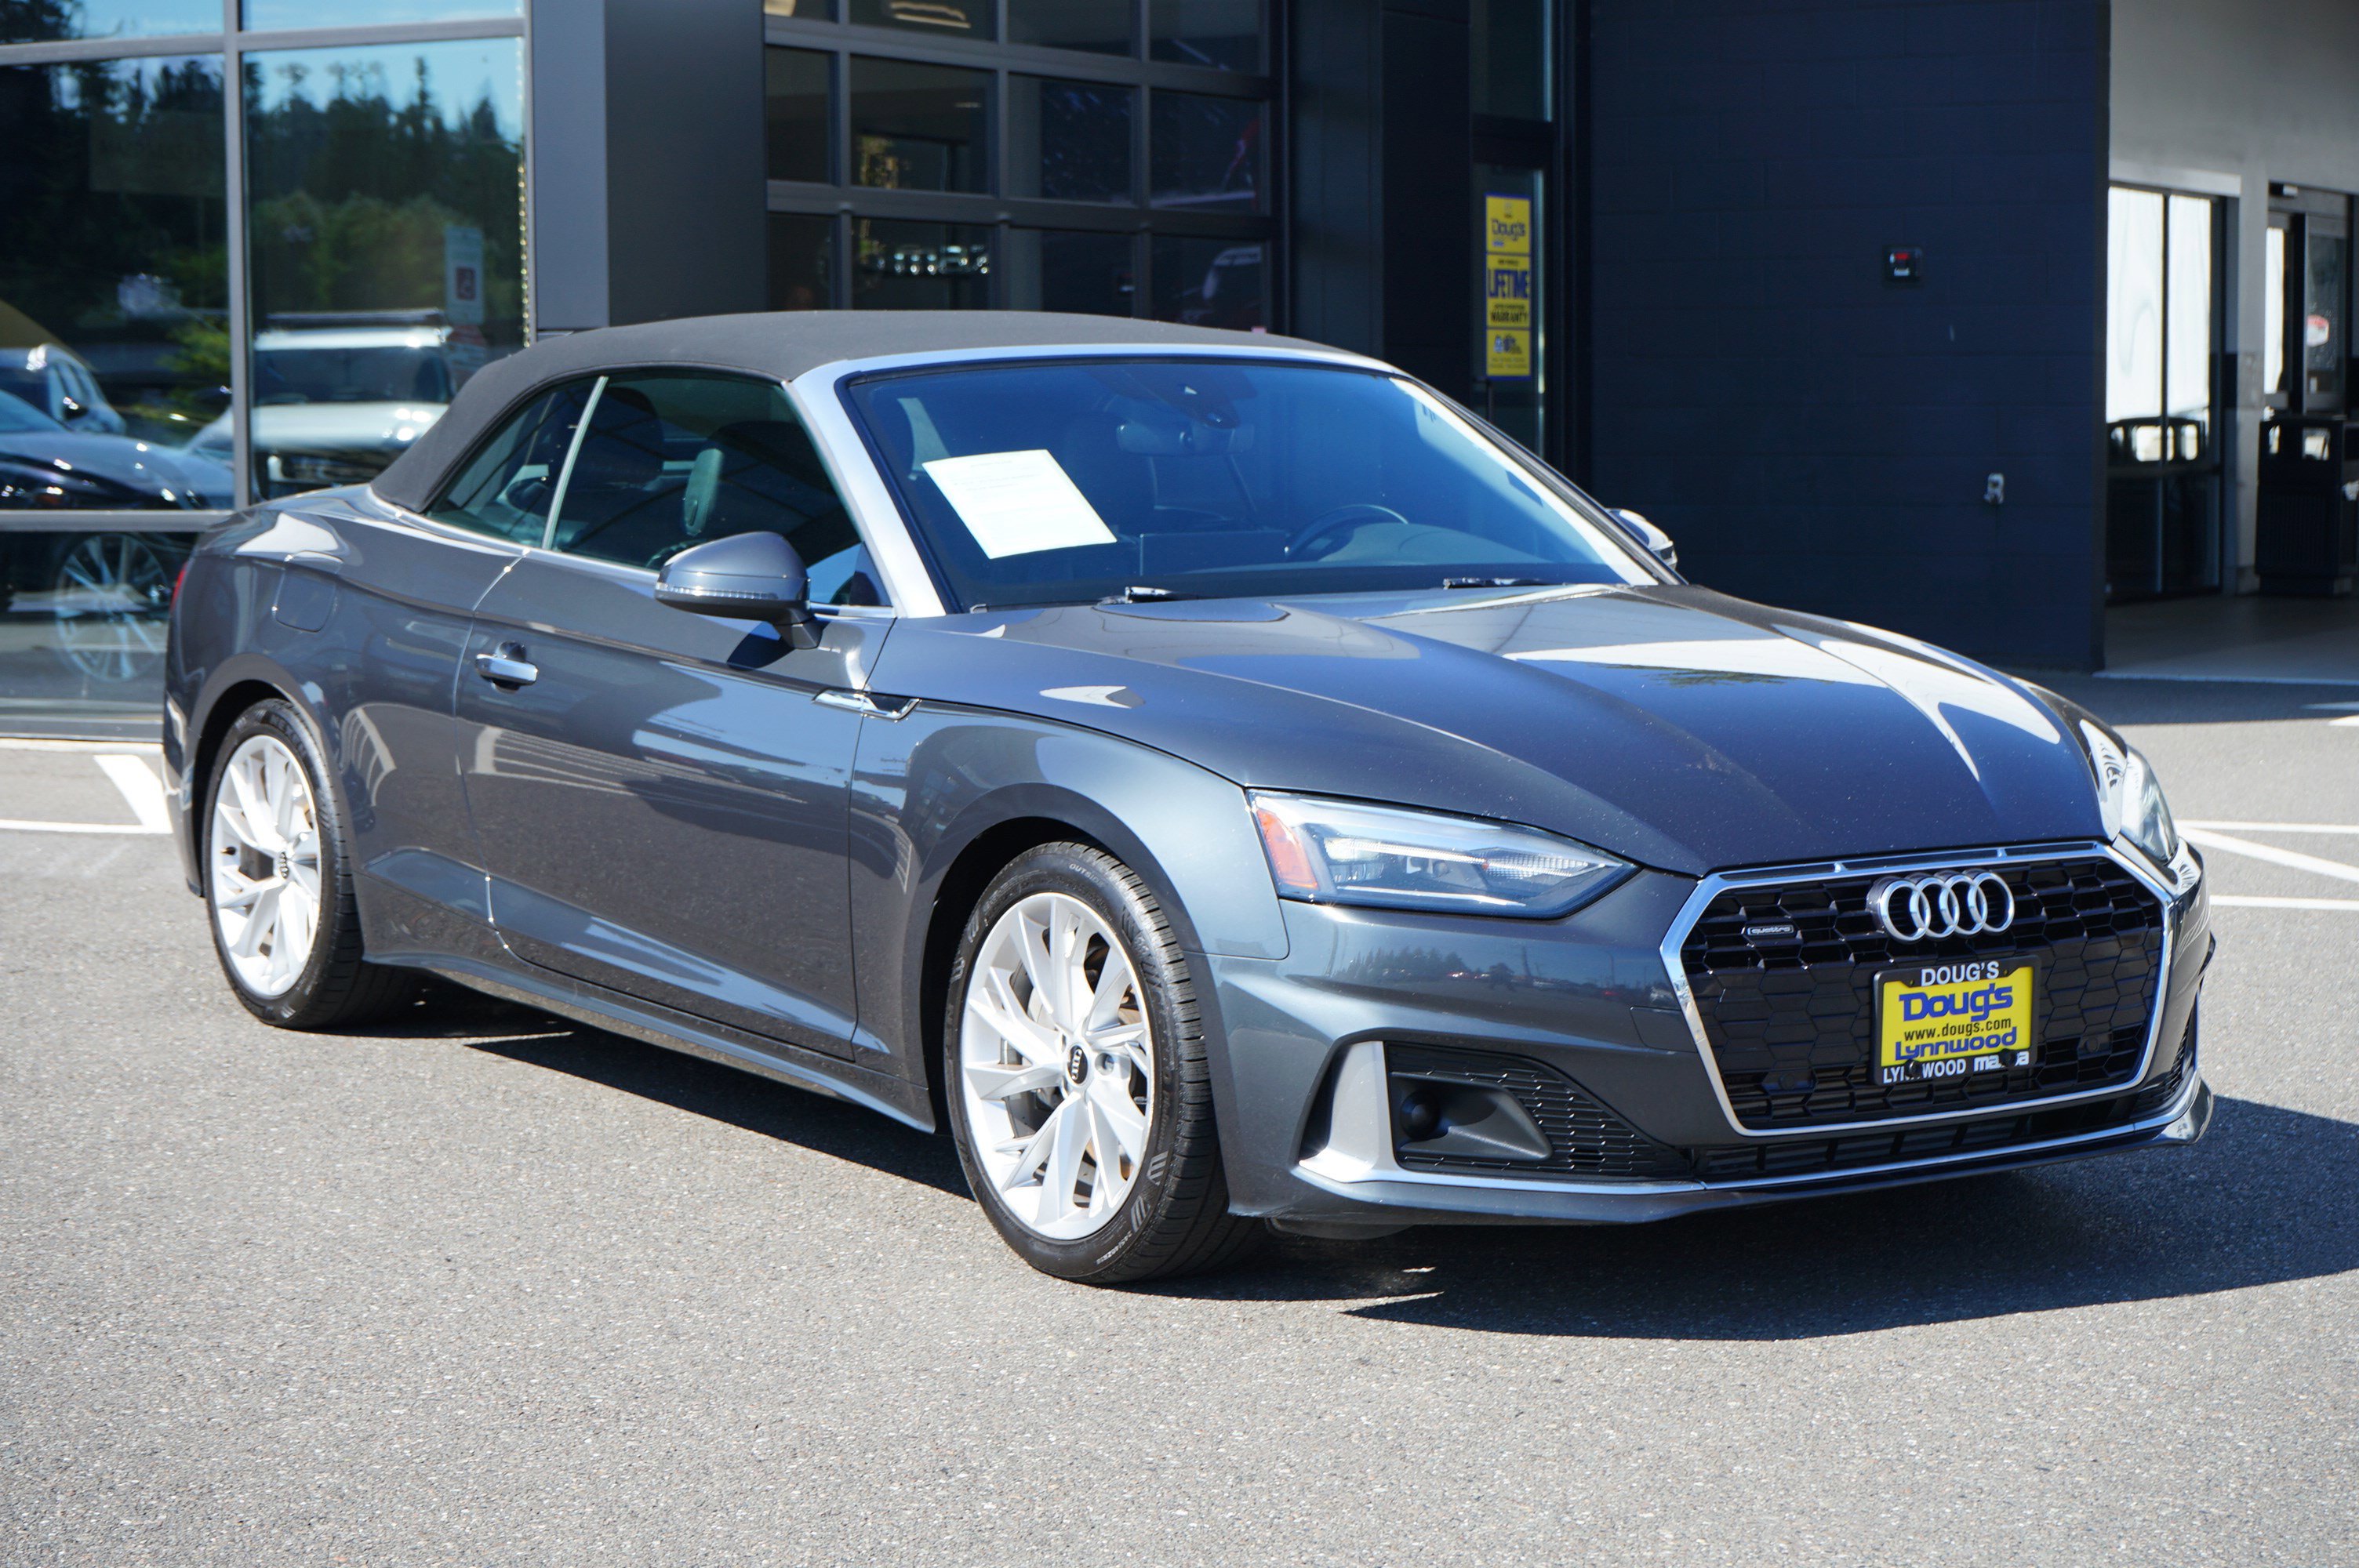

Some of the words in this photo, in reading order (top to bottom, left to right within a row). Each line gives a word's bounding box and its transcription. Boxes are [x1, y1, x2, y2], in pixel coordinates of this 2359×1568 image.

[1488, 270, 1530, 298] LIFETIME
[1921, 961, 2000, 987] DOUG'S
[1904, 1018, 2012, 1041] www.dougs.com
[1896, 1026, 2017, 1061] Lynnwood
[1883, 1058, 1966, 1083] LYWOOD
